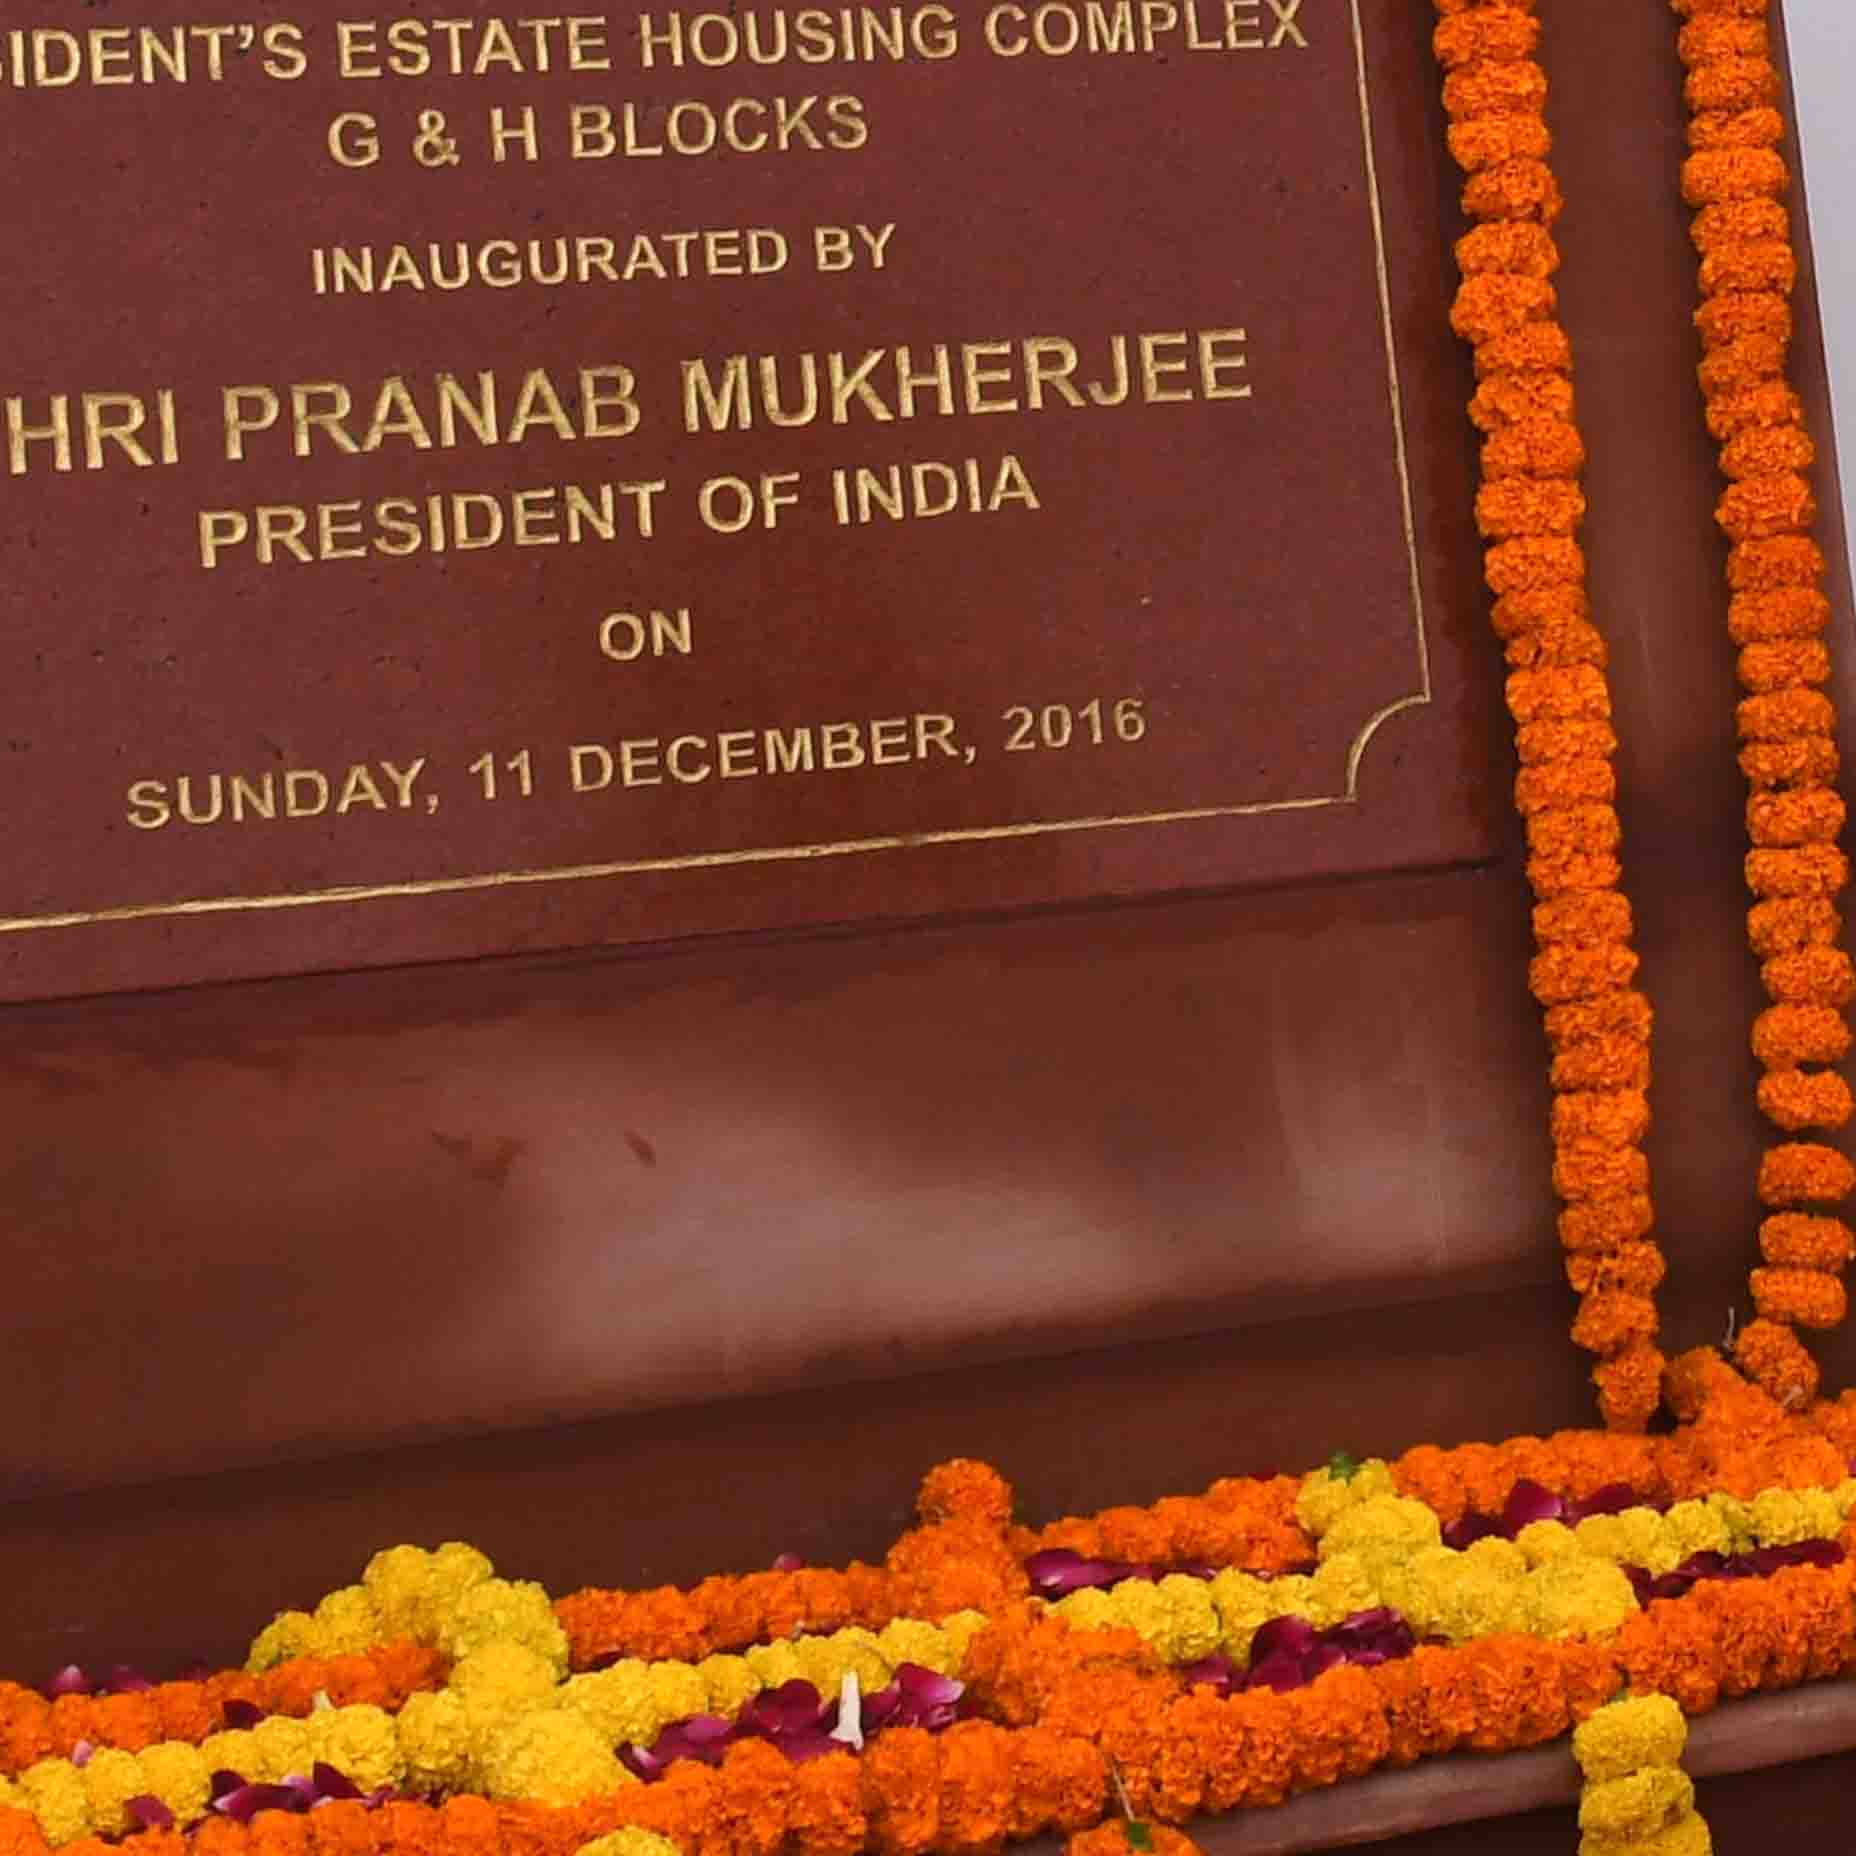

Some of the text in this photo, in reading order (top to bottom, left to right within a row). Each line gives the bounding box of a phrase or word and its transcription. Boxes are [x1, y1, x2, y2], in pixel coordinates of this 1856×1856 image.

[335, 14, 612, 79] ESTATE
[638, 3, 959, 69] HOUSING
[326, 94, 869, 168] G & H BLOCKS
[311, 222, 897, 296] INAUGURATED BY
[222, 364, 642, 461] PRANAB
[680, 326, 1253, 434] MUKHERJEE
[198, 454, 1042, 570] PRESIDENT OF INDIA
[598, 606, 693, 662] ON
[126, 697, 1146, 830] SUNDAY, 11 DECEMBER, 2016
